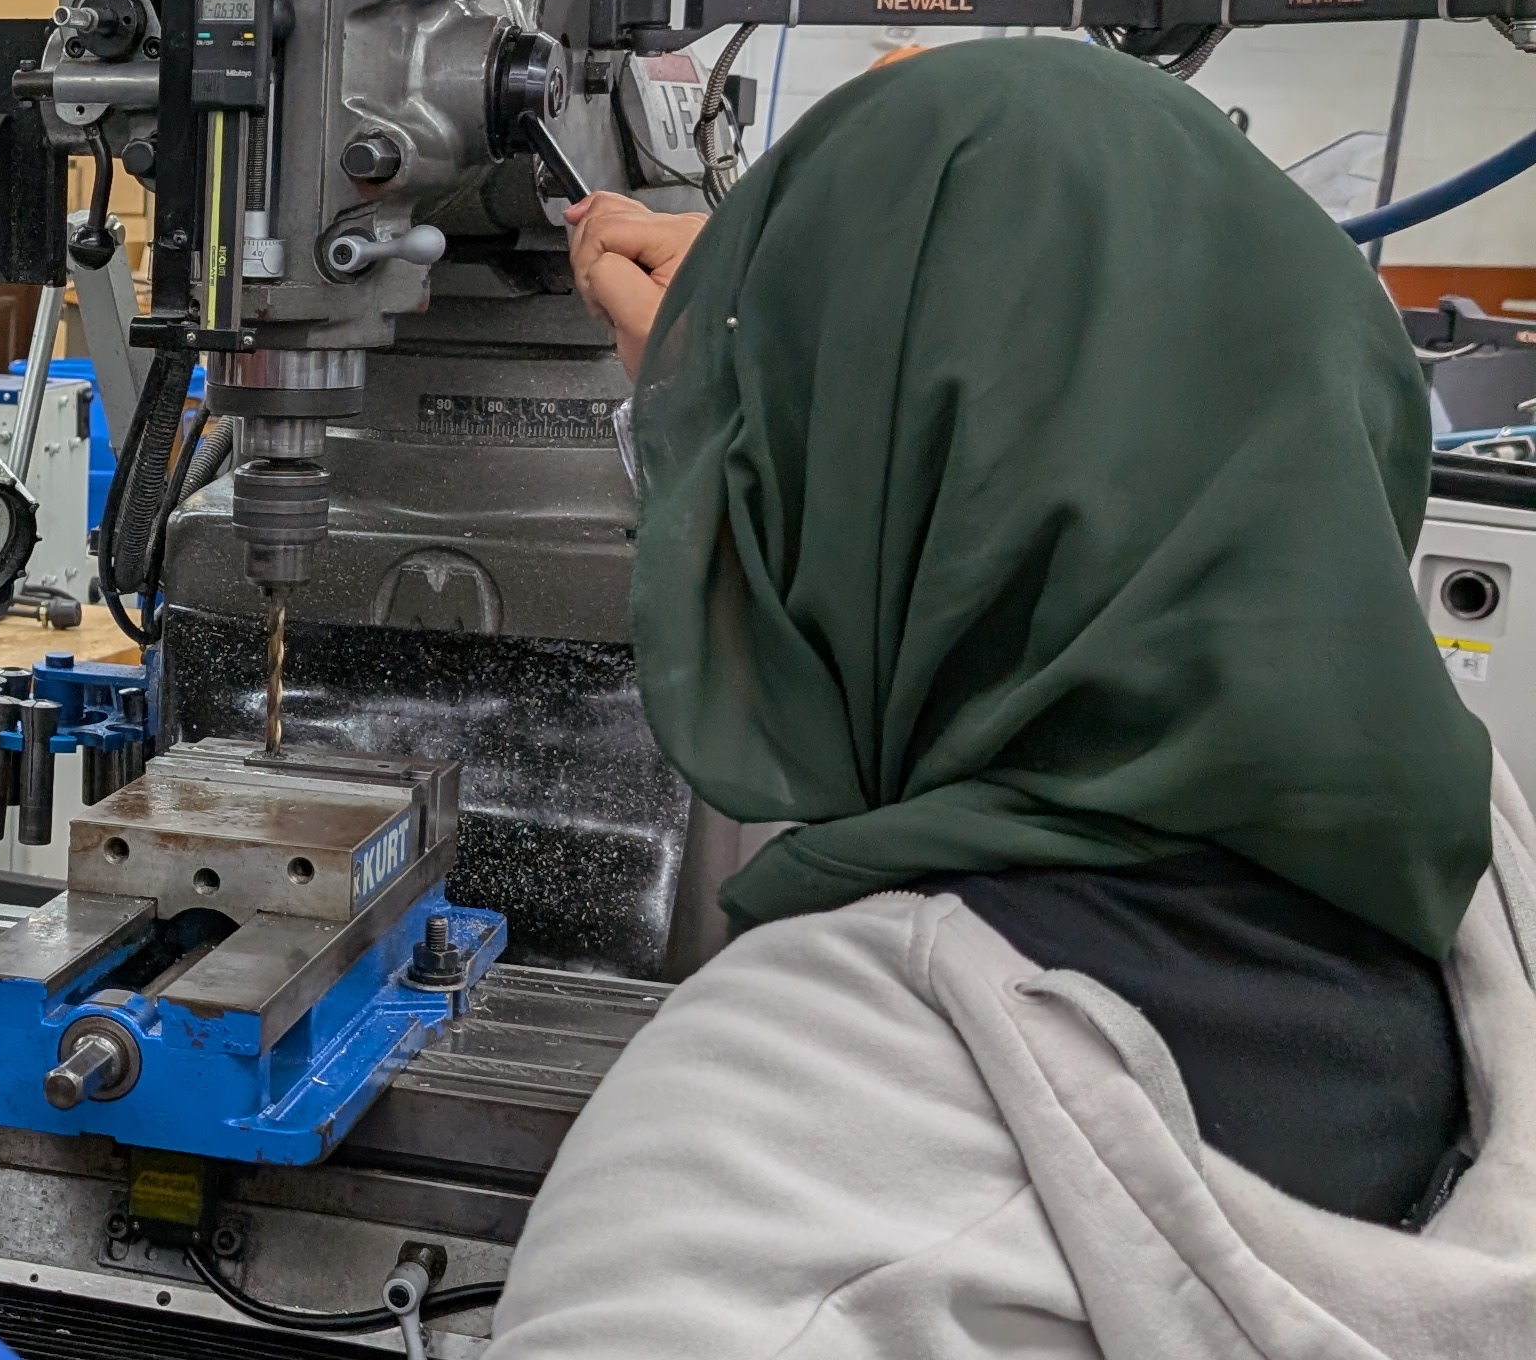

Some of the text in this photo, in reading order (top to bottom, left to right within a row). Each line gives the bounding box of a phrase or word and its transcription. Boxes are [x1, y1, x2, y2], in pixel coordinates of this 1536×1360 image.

[436, 398, 607, 414] 90 80 70 60
[362, 817, 410, 896] KURT
